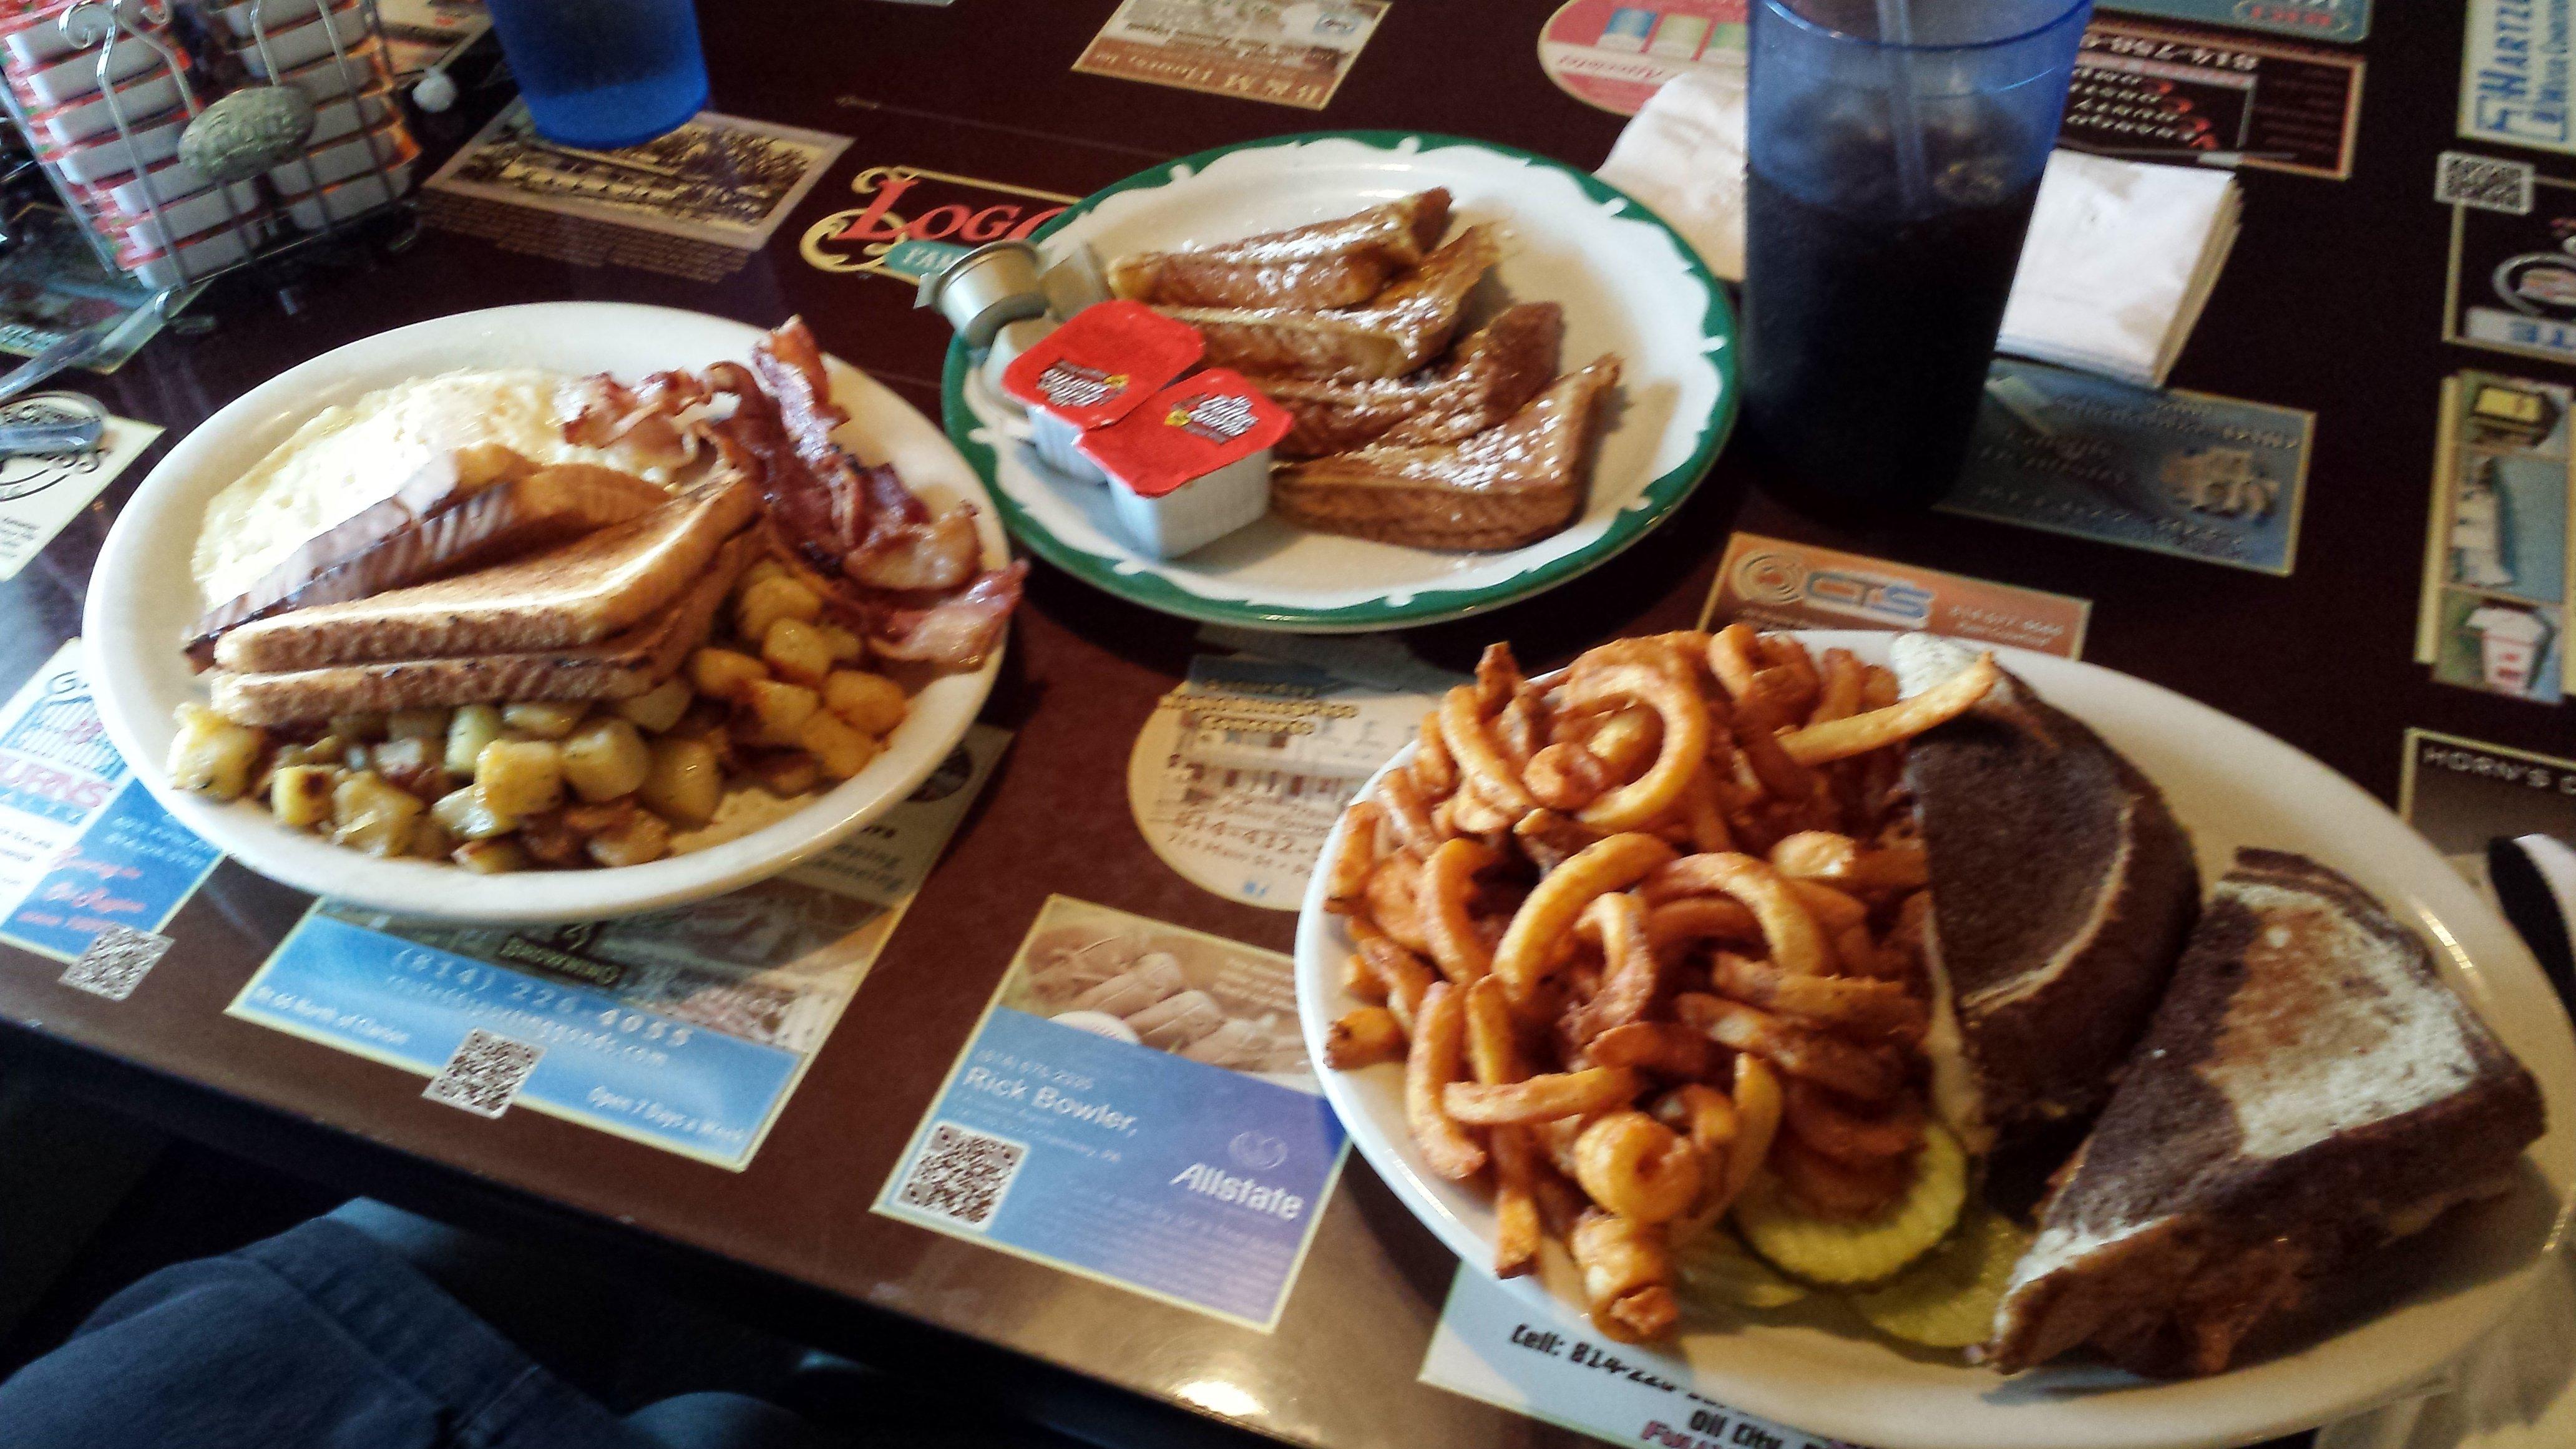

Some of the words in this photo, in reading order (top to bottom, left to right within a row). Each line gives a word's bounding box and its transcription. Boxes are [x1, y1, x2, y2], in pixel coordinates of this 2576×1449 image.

[963, 1065, 1030, 1100] Rick
[1031, 1085, 1138, 1138] Bowler,
[1169, 1162, 1305, 1222] Allstate
[1511, 1322, 1565, 1356] Cell:
